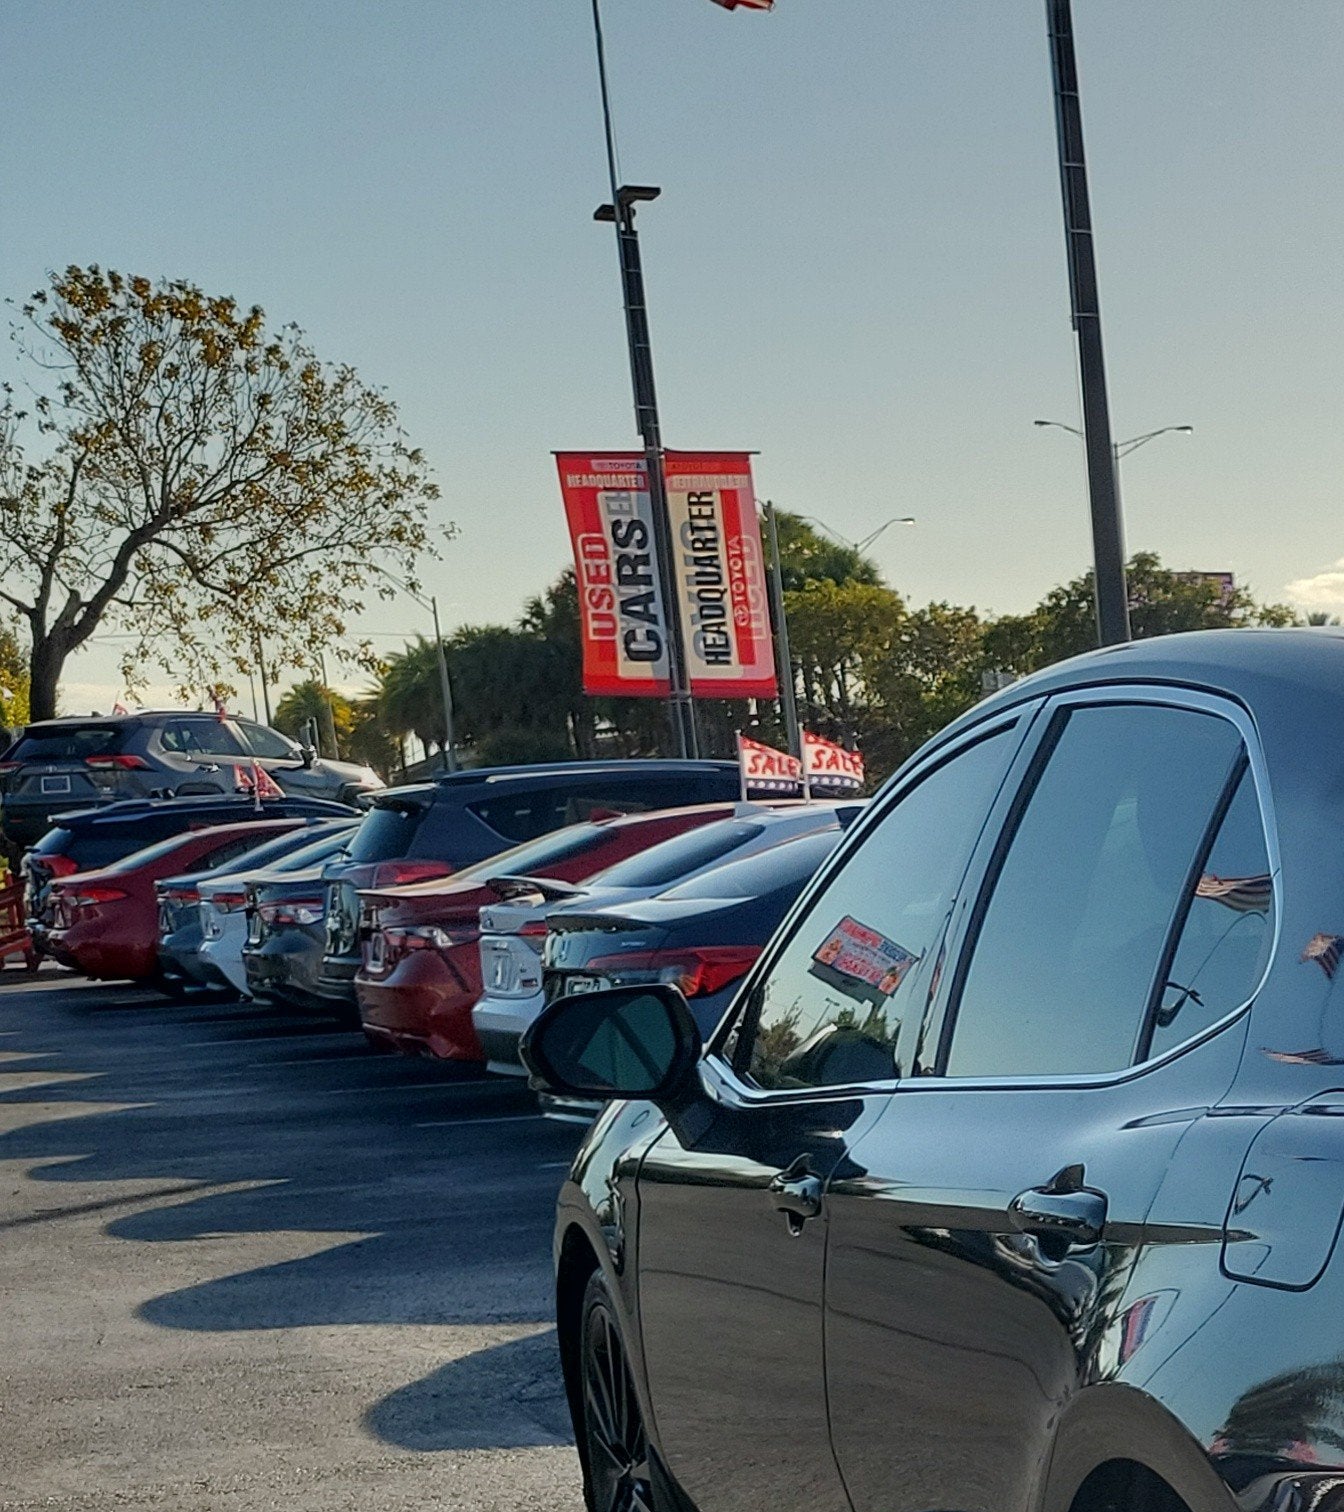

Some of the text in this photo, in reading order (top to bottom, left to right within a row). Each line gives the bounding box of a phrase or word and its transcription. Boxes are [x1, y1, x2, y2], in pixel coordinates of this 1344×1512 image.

[567, 474, 645, 489] HEADQUARTER
[578, 533, 617, 640] USED
[611, 518, 664, 662] CARS
[687, 491, 731, 666] HEADQUARTER
[727, 535, 745, 604] TOYOTA
[748, 754, 797, 777] SALE
[811, 749, 860, 775] SALE
